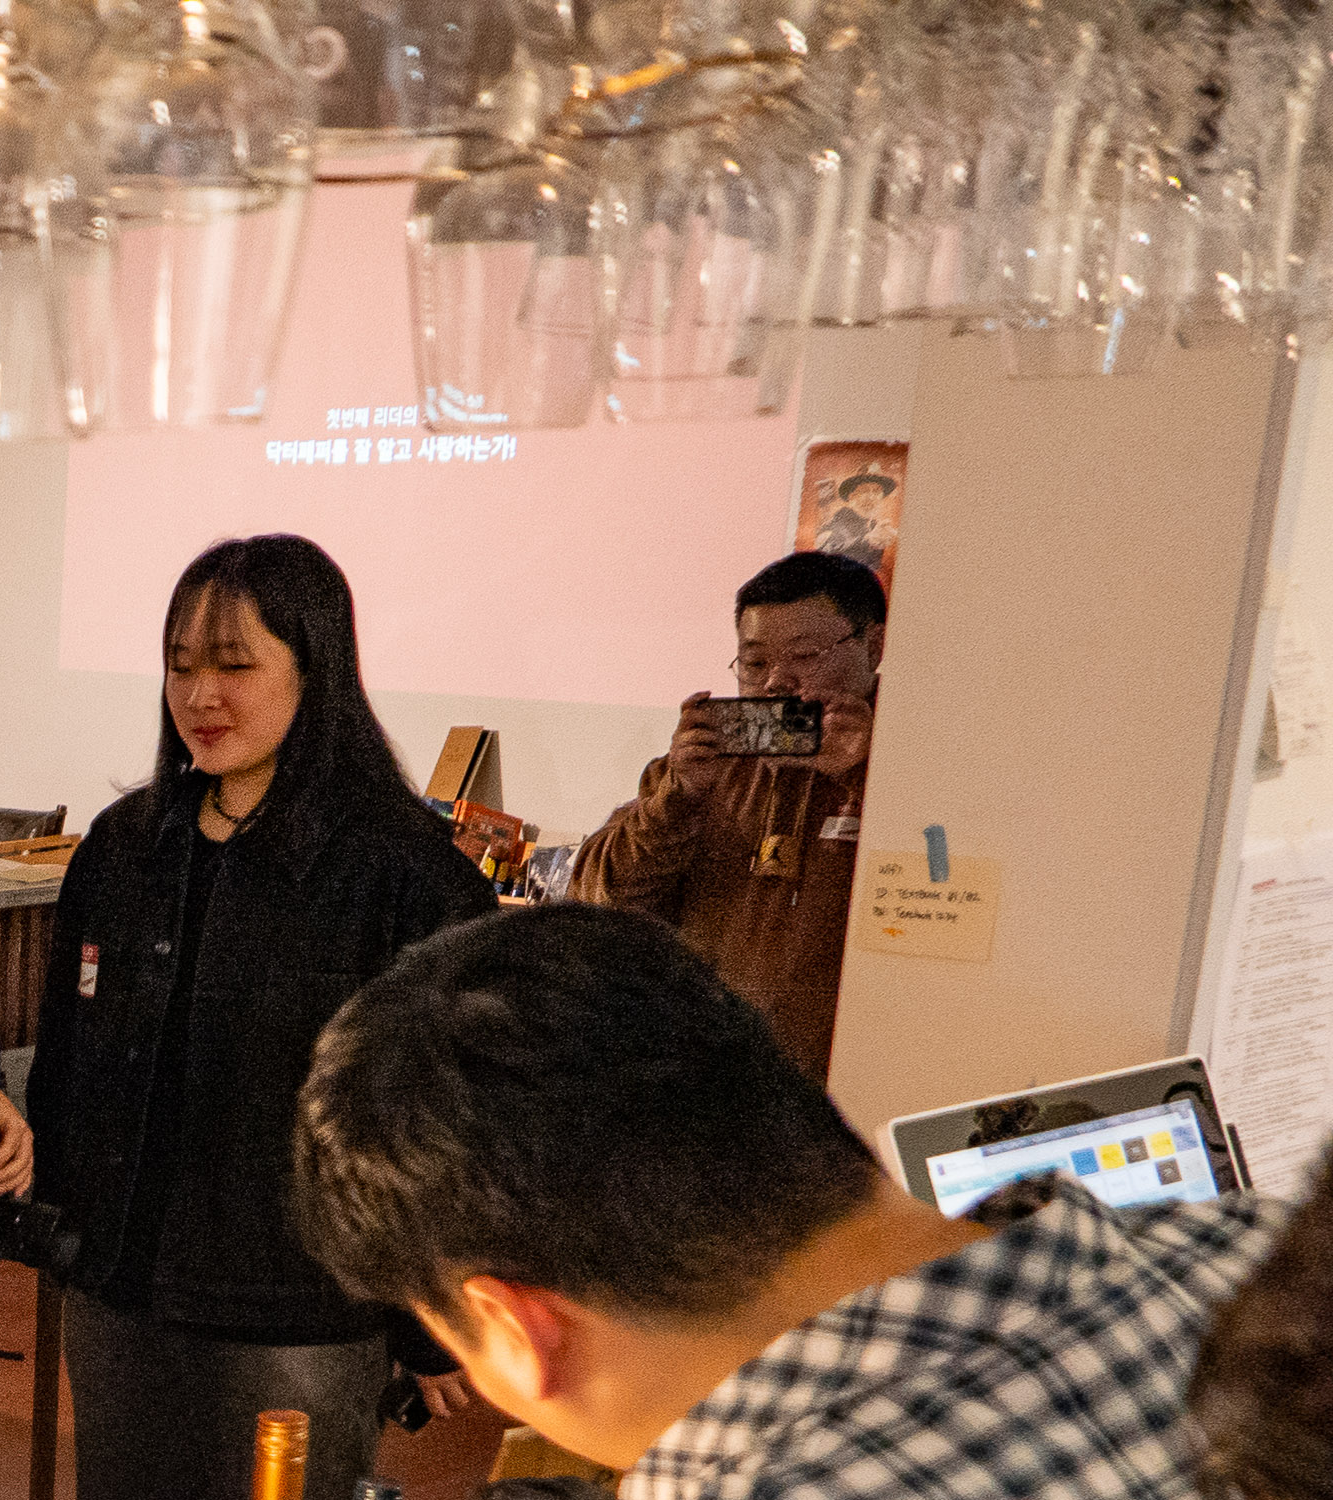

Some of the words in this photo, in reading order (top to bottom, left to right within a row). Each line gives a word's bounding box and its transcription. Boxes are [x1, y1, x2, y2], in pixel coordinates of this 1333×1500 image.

[326, 406, 370, 429] 첫번째
[373, 404, 419, 428] 리더의
[353, 436, 373, 464] 잘
[377, 436, 413, 464] 알고
